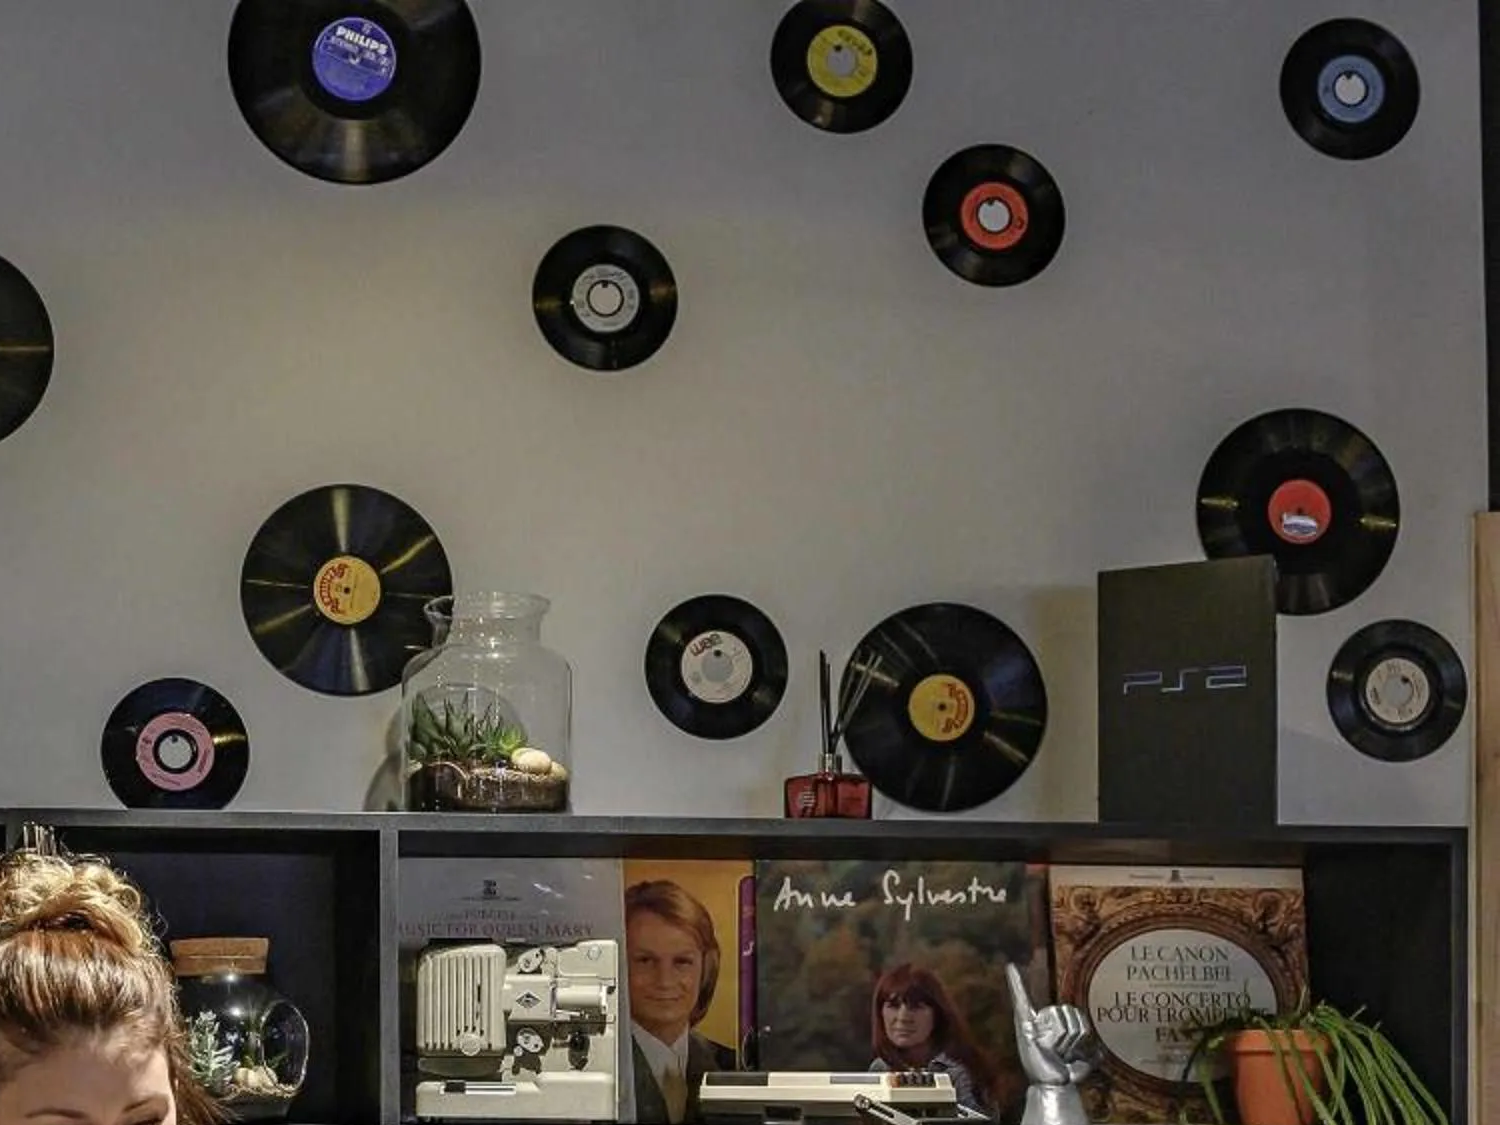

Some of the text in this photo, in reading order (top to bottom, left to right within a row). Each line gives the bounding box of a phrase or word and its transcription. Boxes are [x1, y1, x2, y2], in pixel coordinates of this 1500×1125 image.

[336, 25, 388, 55] PHILIPS
[1123, 664, 1248, 696] PS2
[774, 870, 1007, 922] Anne Sylvestre
[547, 922, 593, 937] MARY
[1131, 946, 1229, 961] LE CANON
[1127, 965, 1232, 982] PACHELBEL
[1115, 991, 1252, 1009] LE CONCERTO
[1097, 1007, 1149, 1023] POUR
